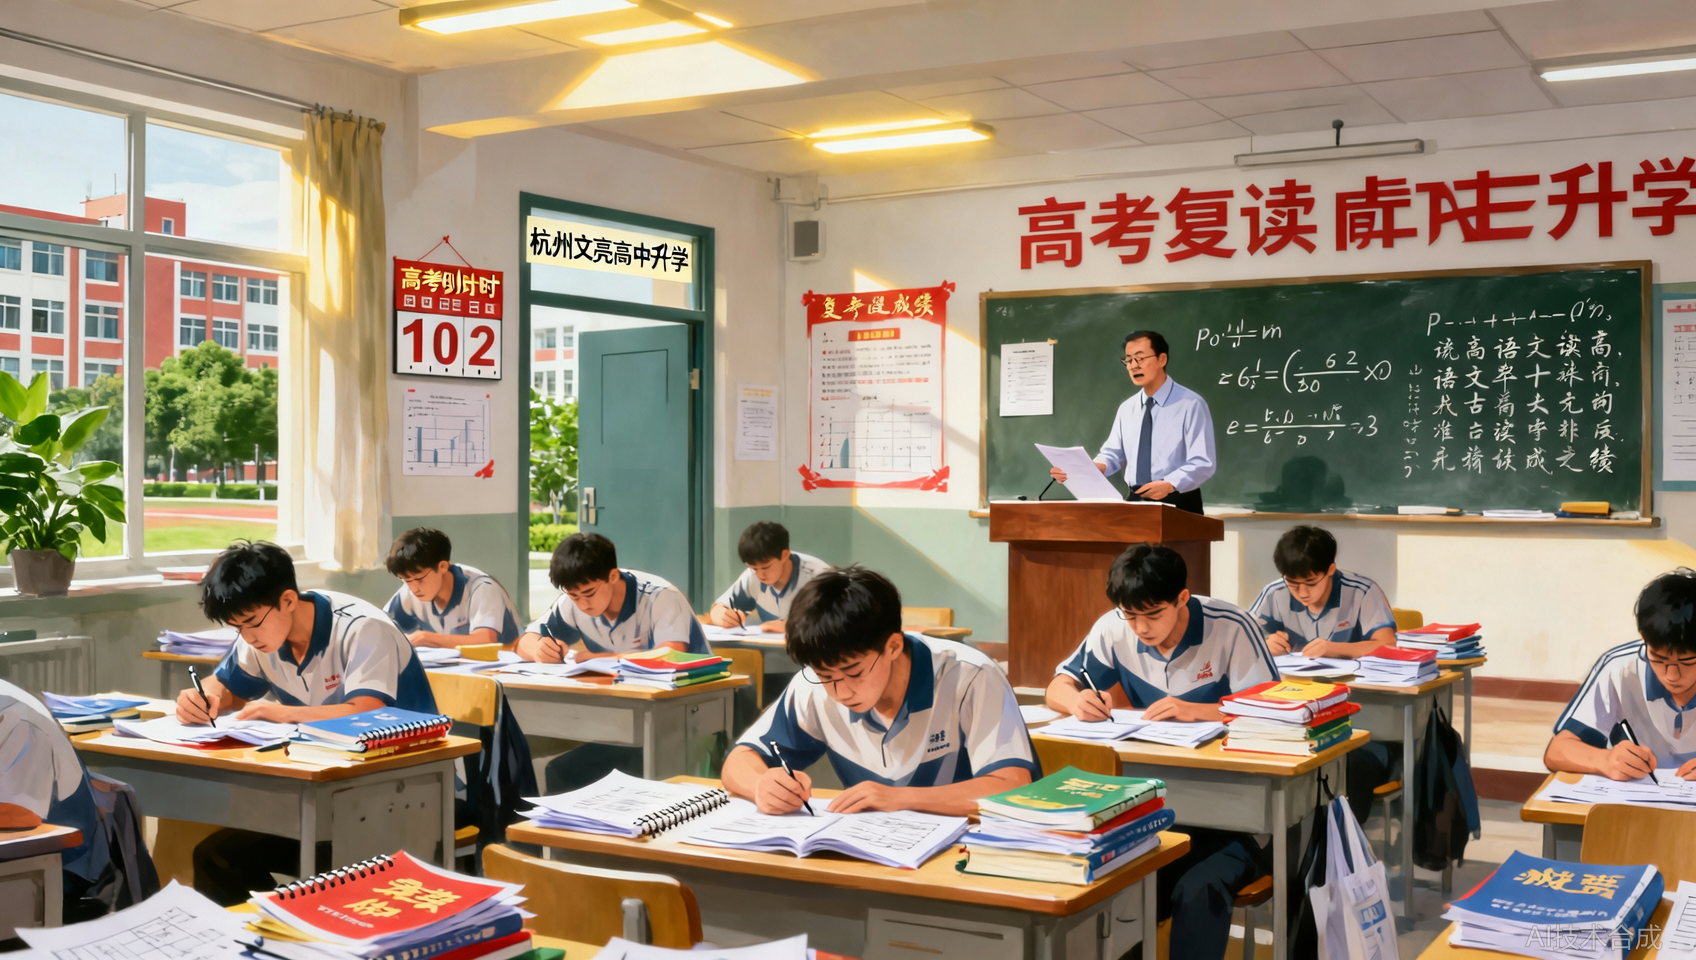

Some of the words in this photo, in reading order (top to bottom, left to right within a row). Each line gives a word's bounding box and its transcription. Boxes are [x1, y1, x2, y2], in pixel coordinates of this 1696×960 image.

[1017, 179, 1318, 270] 高考复读
[530, 227, 689, 272] 杭州文亮高中升学
[402, 318, 496, 367] 102
